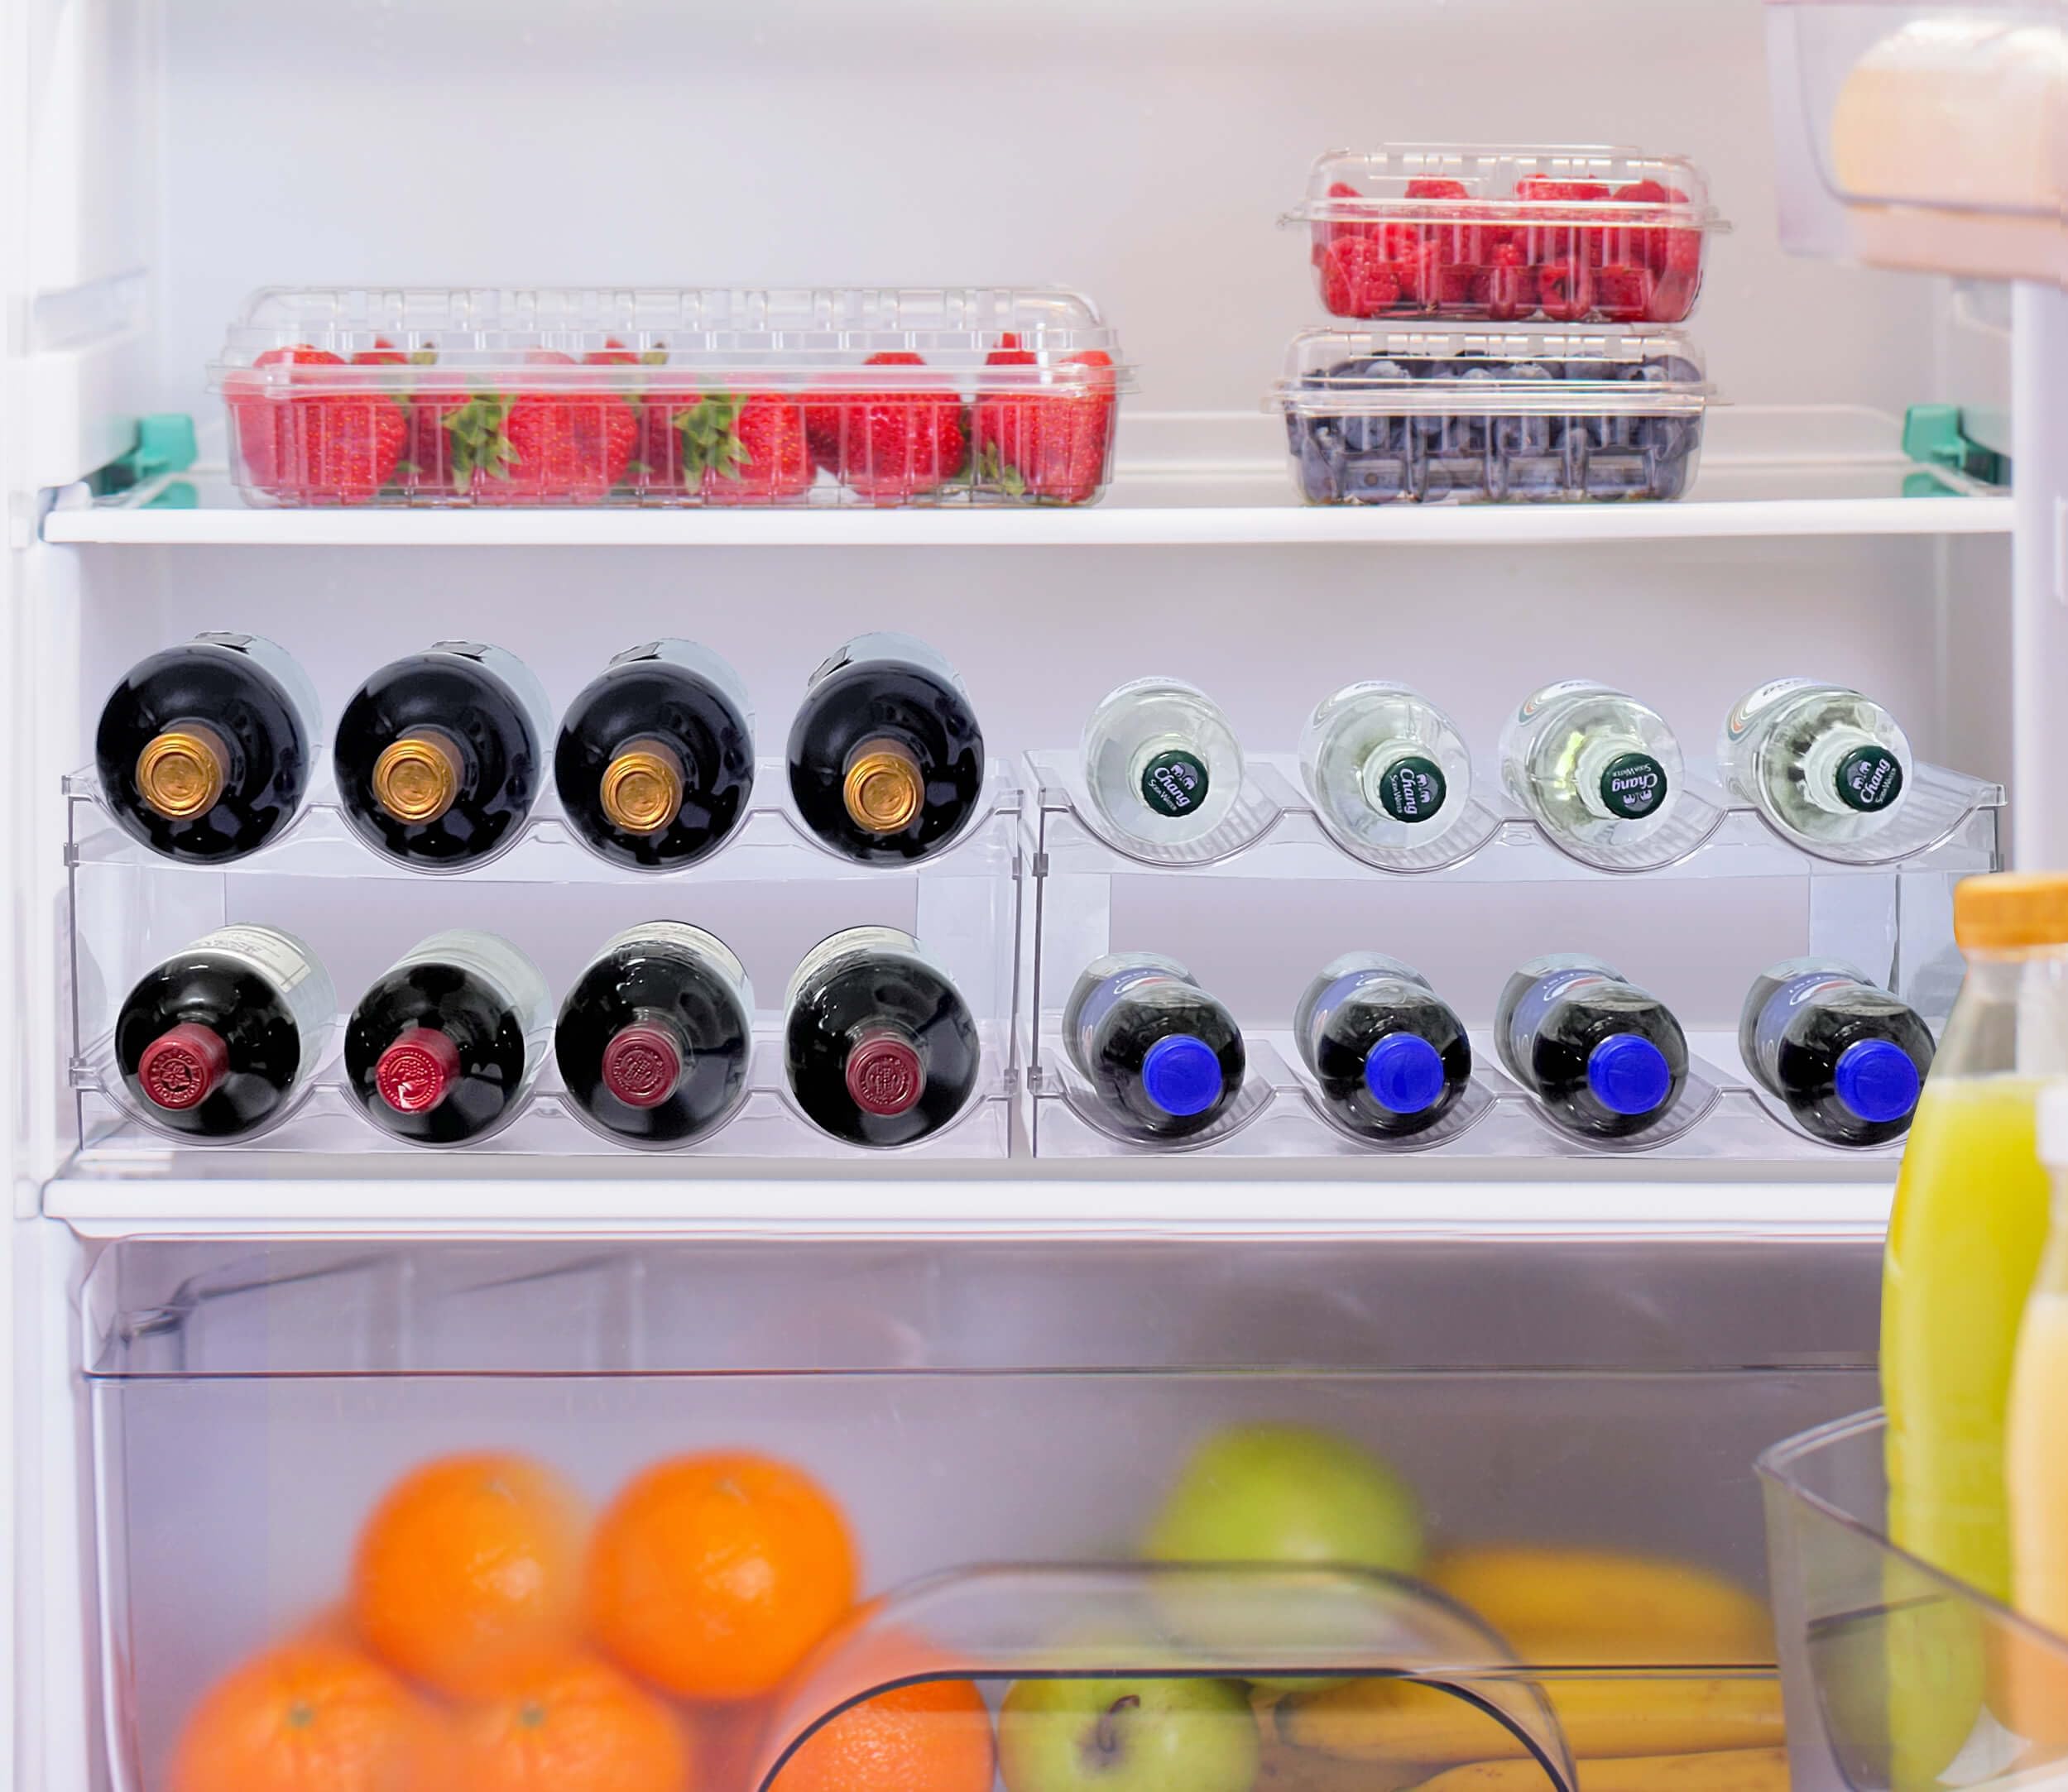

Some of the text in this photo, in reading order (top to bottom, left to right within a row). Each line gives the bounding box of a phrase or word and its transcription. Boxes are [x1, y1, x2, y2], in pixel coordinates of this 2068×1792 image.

[1154, 767, 1190, 807] Chang
[1400, 768, 1418, 814] Chang
[1612, 773, 1658, 792] Chang
[1860, 759, 1890, 803] Chang
